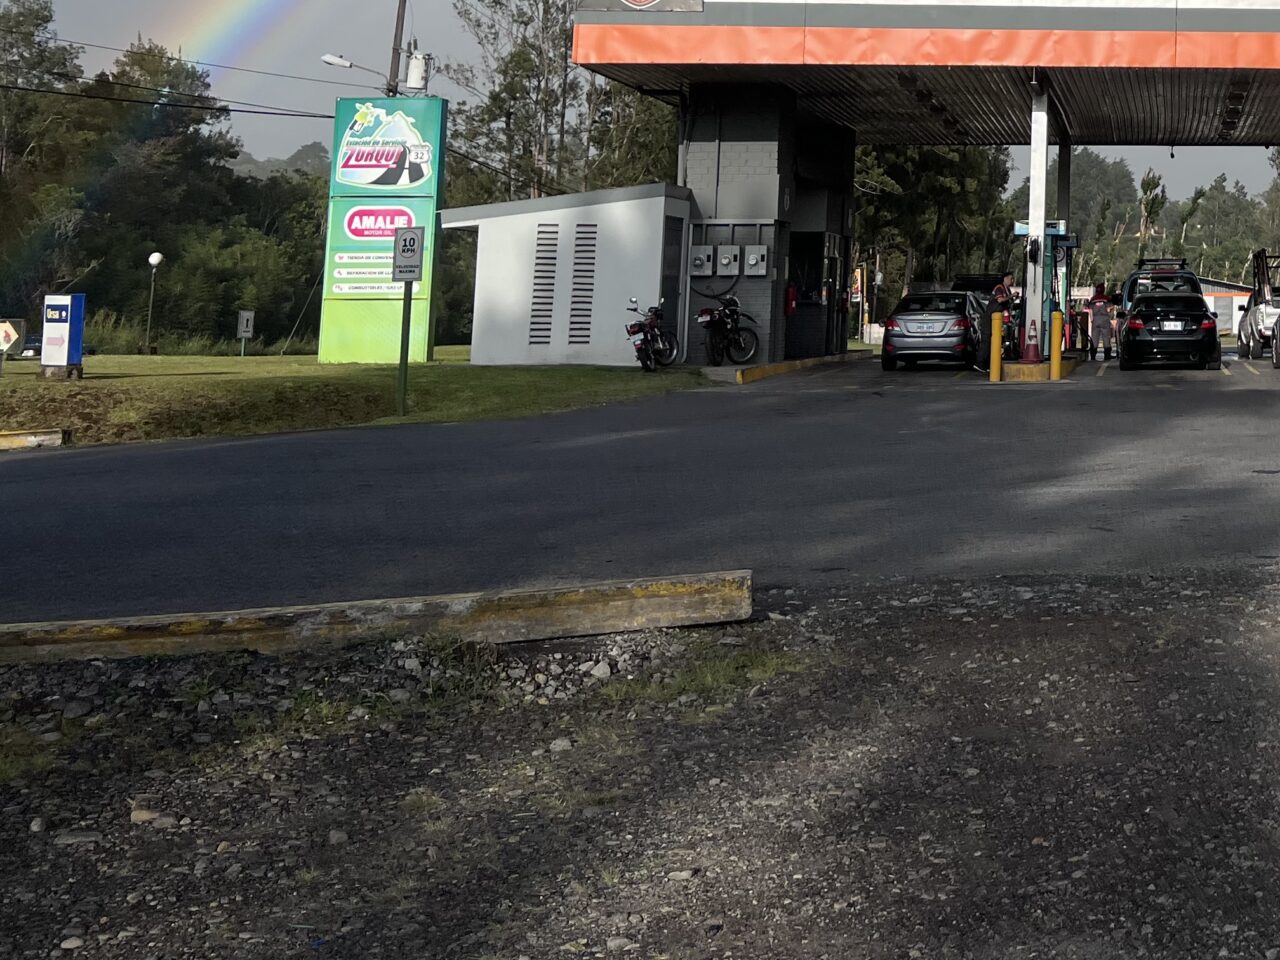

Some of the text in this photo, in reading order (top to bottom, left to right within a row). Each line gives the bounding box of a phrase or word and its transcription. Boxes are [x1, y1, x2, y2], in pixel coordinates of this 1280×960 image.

[413, 151, 425, 160] 32
[351, 215, 408, 230] AMALIE
[402, 237, 416, 248] 10
